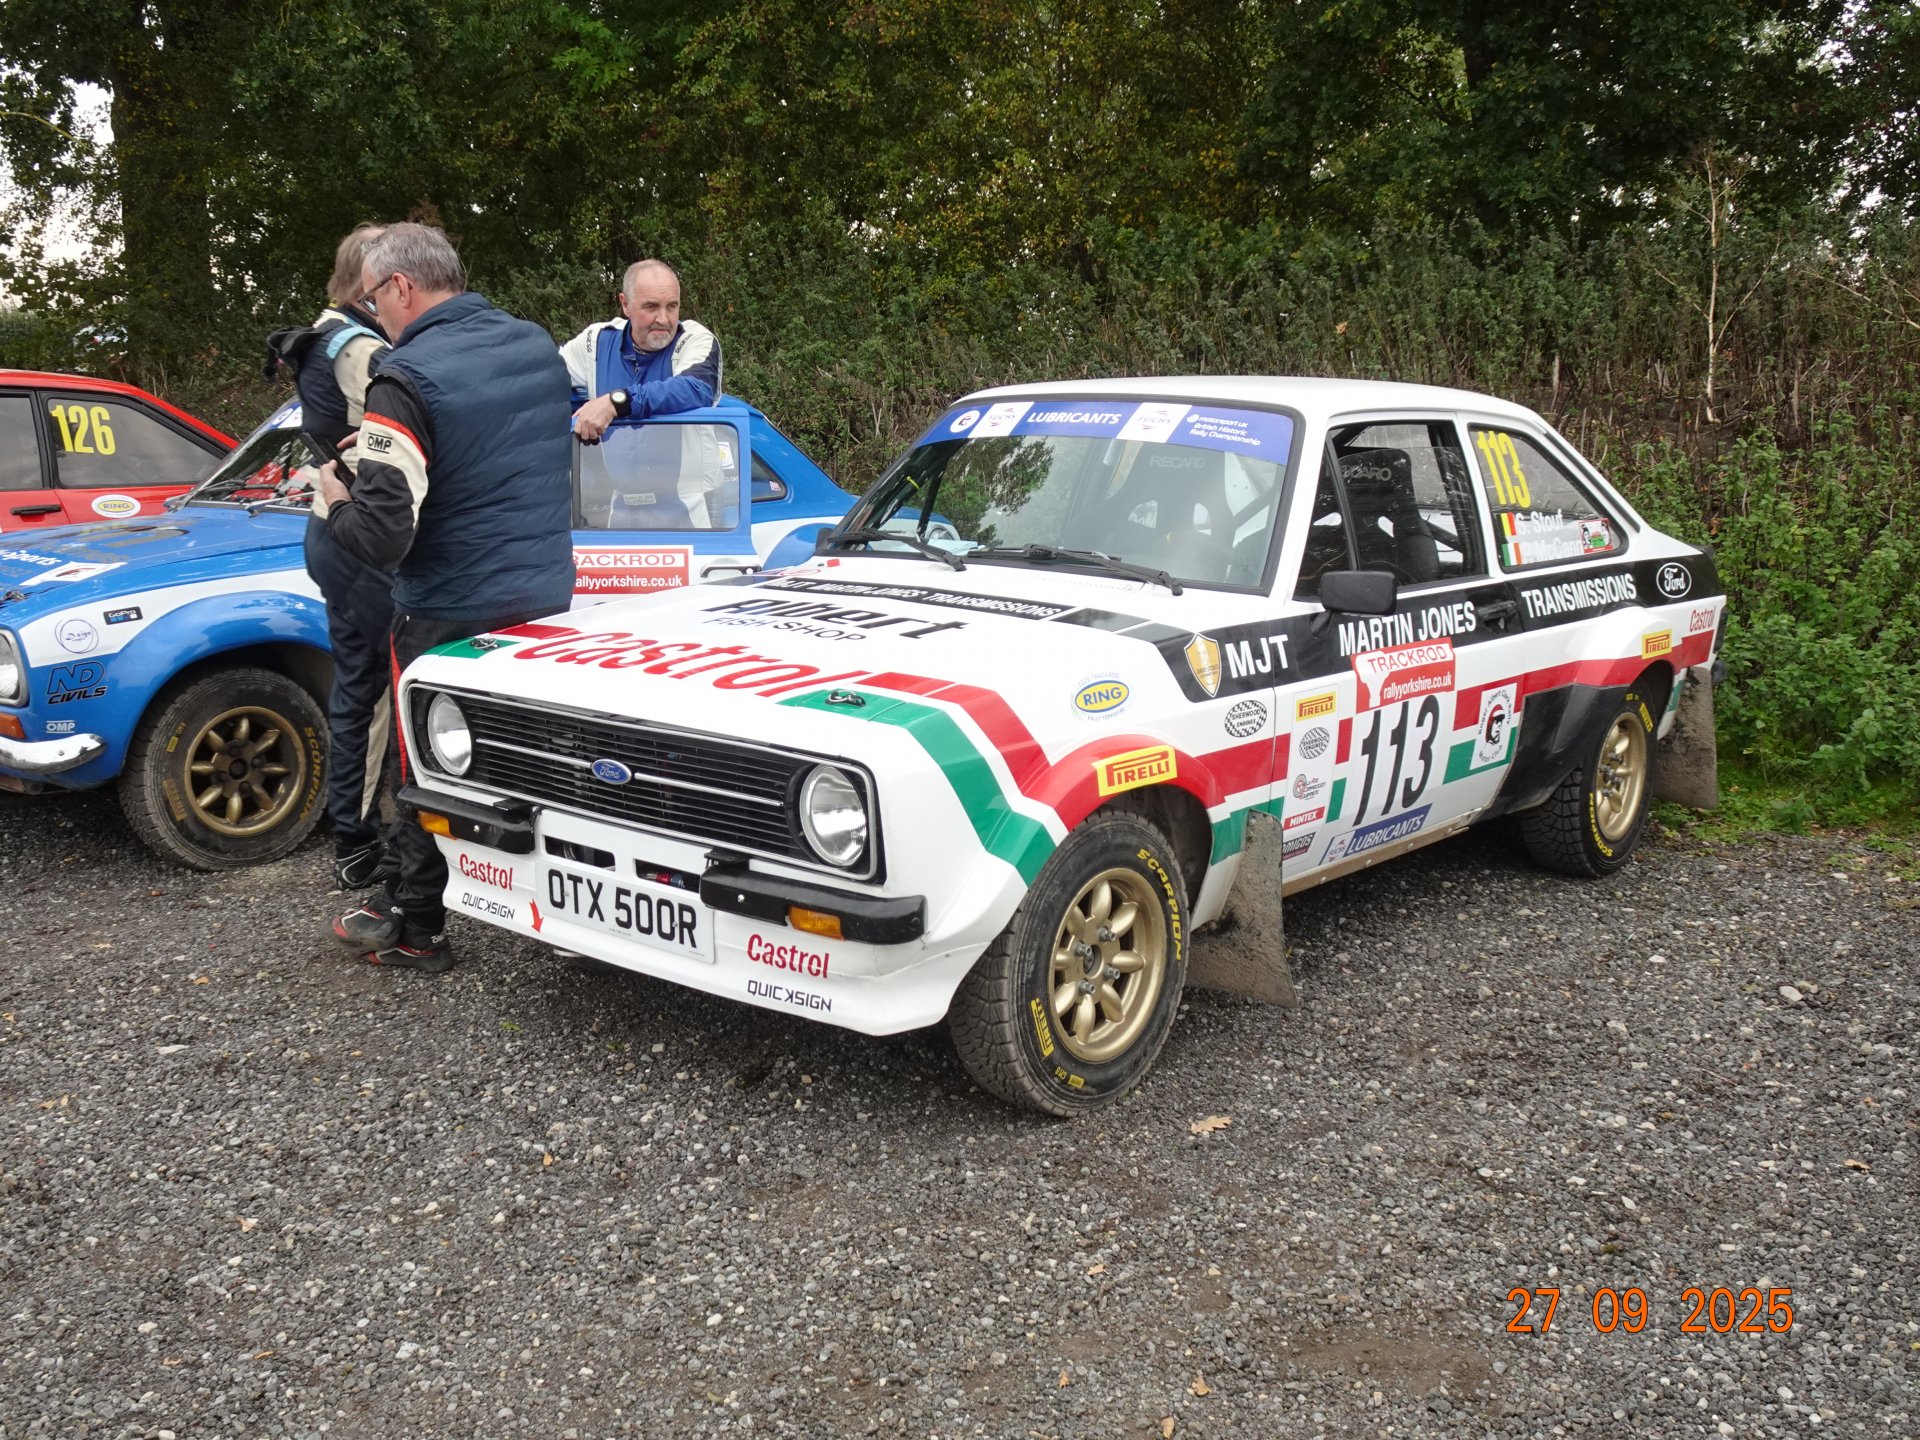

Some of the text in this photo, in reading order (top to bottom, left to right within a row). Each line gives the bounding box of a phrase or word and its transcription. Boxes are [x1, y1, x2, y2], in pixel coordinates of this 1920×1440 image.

[51, 404, 116, 456] 126
[1027, 411, 1122, 425] LUBRICANTS
[1194, 422, 1248, 436] British Historic
[367, 435, 392, 451] OMP
[1190, 429, 1261, 446] Rally Championship
[1476, 430, 1531, 508] 113
[1664, 567, 1686, 592] Ford
[922, 591, 1061, 617] TRANSMISSIONS
[1522, 573, 1637, 618] TRANSMISSIONS
[108, 609, 137, 618] GoPro
[1690, 605, 1717, 632] Castrol
[703, 616, 867, 642] FISH SHOP
[1338, 601, 1476, 657] MARTIN JONES
[1225, 634, 1289, 679] MJT
[1646, 634, 1671, 654] PIRELLI
[514, 631, 873, 698] Castrol
[1367, 646, 1447, 674] TRACKROD
[47, 661, 105, 695] ND
[1383, 673, 1452, 700] rallyyorkshire.co.uk
[48, 686, 107, 704] CIVILS
[1083, 687, 1122, 706] RING
[1299, 695, 1334, 718] PIRELLI
[46, 722, 76, 732] OMP
[1231, 708, 1261, 720] SHERWOOD
[600, 763, 621, 779] Ford
[1105, 750, 1170, 788] PIRELLI
[1352, 694, 1440, 827] 113
[1289, 810, 1318, 828] MINTEX
[1348, 814, 1424, 854] LUBRICANTS
[459, 853, 513, 891] Castrol
[461, 892, 515, 921] QUICKSIGN
[548, 868, 698, 949] OTX 500R
[1137, 848, 1182, 961] SCORPION
[747, 934, 830, 979] Castrol
[747, 979, 833, 1012] QUICKSIGN
